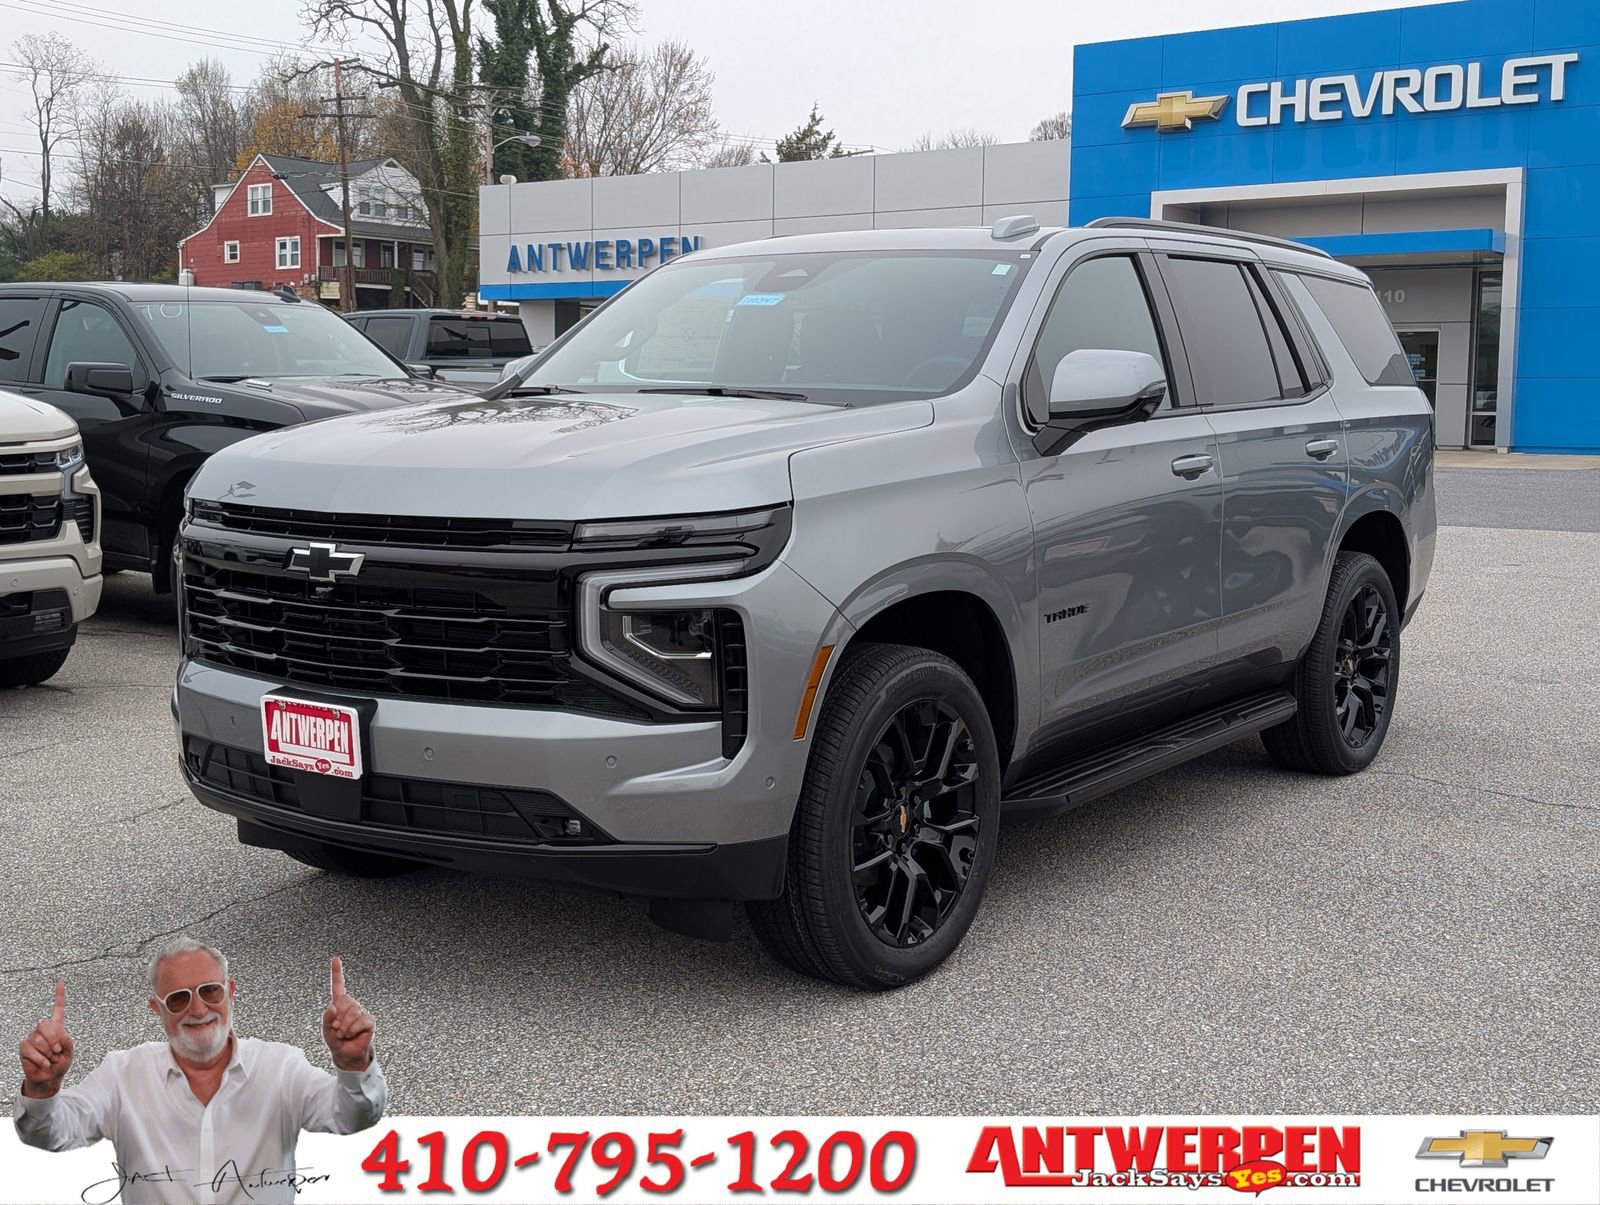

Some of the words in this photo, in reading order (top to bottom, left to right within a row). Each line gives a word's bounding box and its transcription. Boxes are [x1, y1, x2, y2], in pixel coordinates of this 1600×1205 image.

[1236, 52, 1579, 127] CHEVROLET
[170, 392, 223, 404] SILVERADO
[1043, 603, 1089, 624] TAHOE
[270, 709, 350, 756] ANTWERPEN
